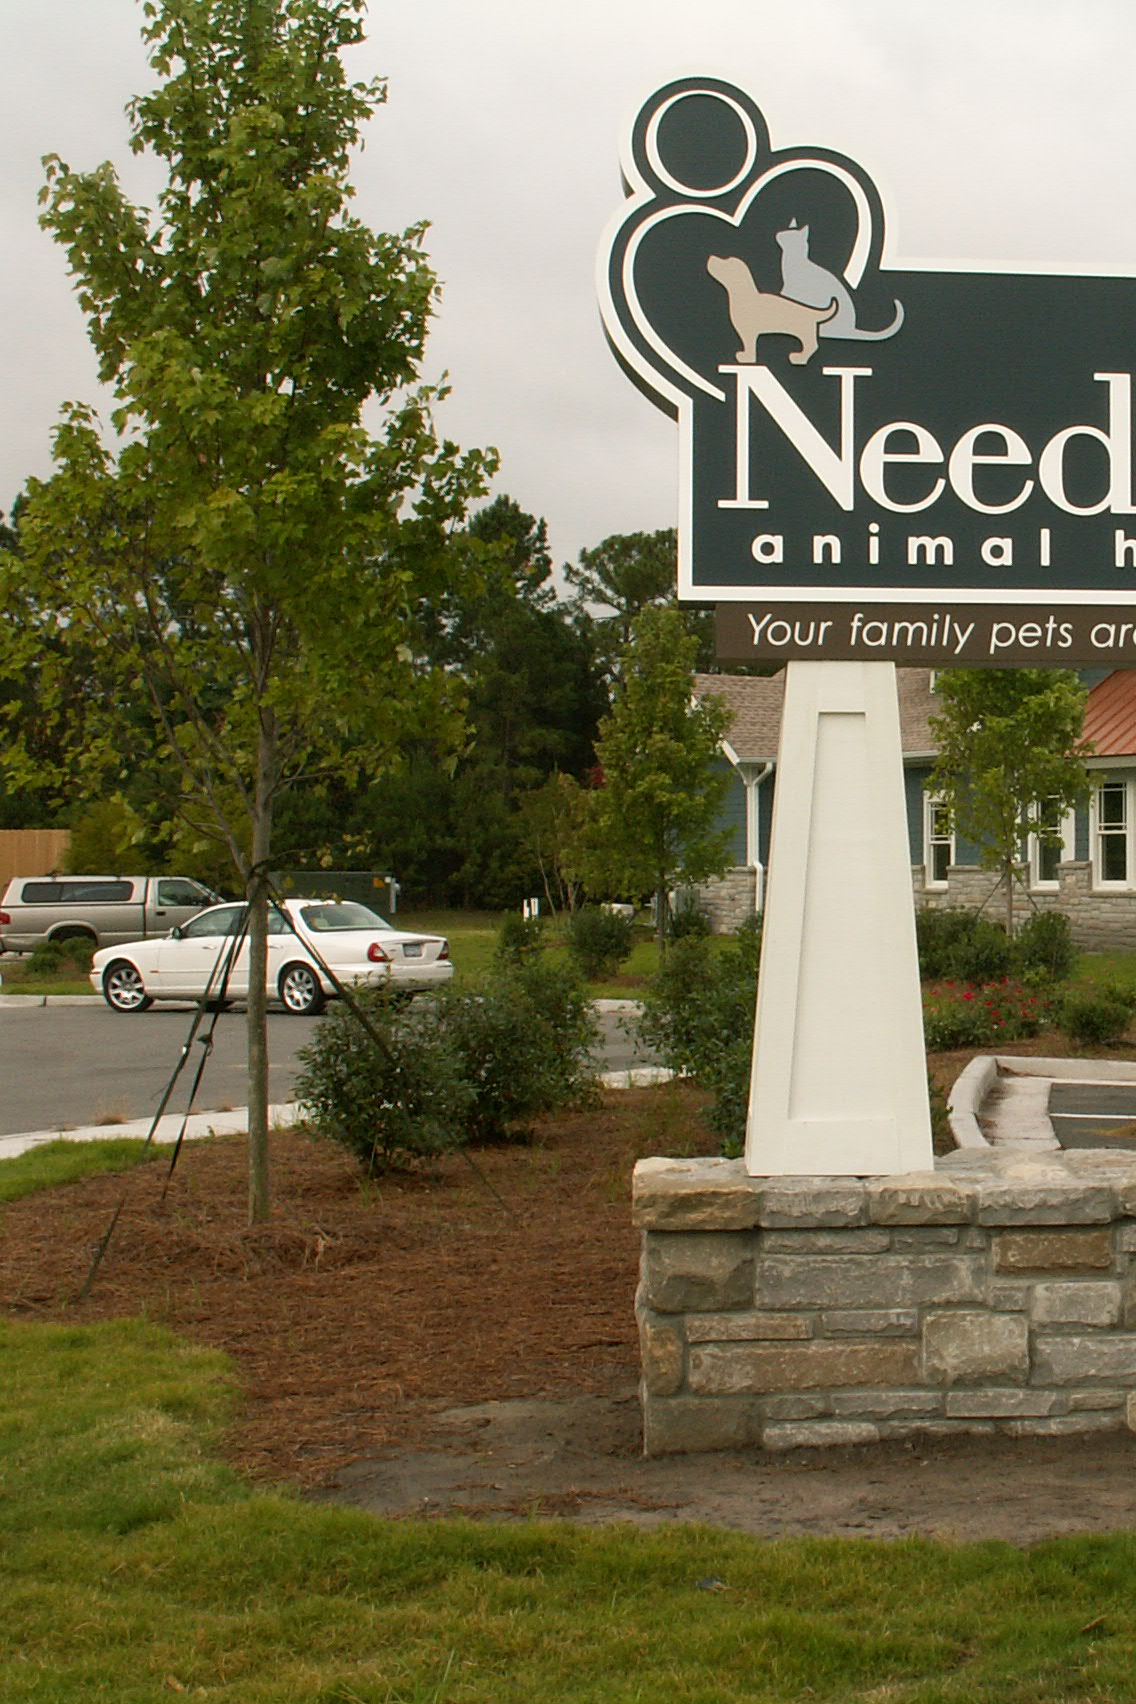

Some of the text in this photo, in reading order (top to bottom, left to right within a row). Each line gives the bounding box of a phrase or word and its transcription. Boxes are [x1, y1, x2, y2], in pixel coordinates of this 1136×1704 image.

[751, 522, 1052, 568] animal
[746, 612, 833, 647] Your
[850, 612, 976, 656] family
[988, 614, 1074, 656] pets
